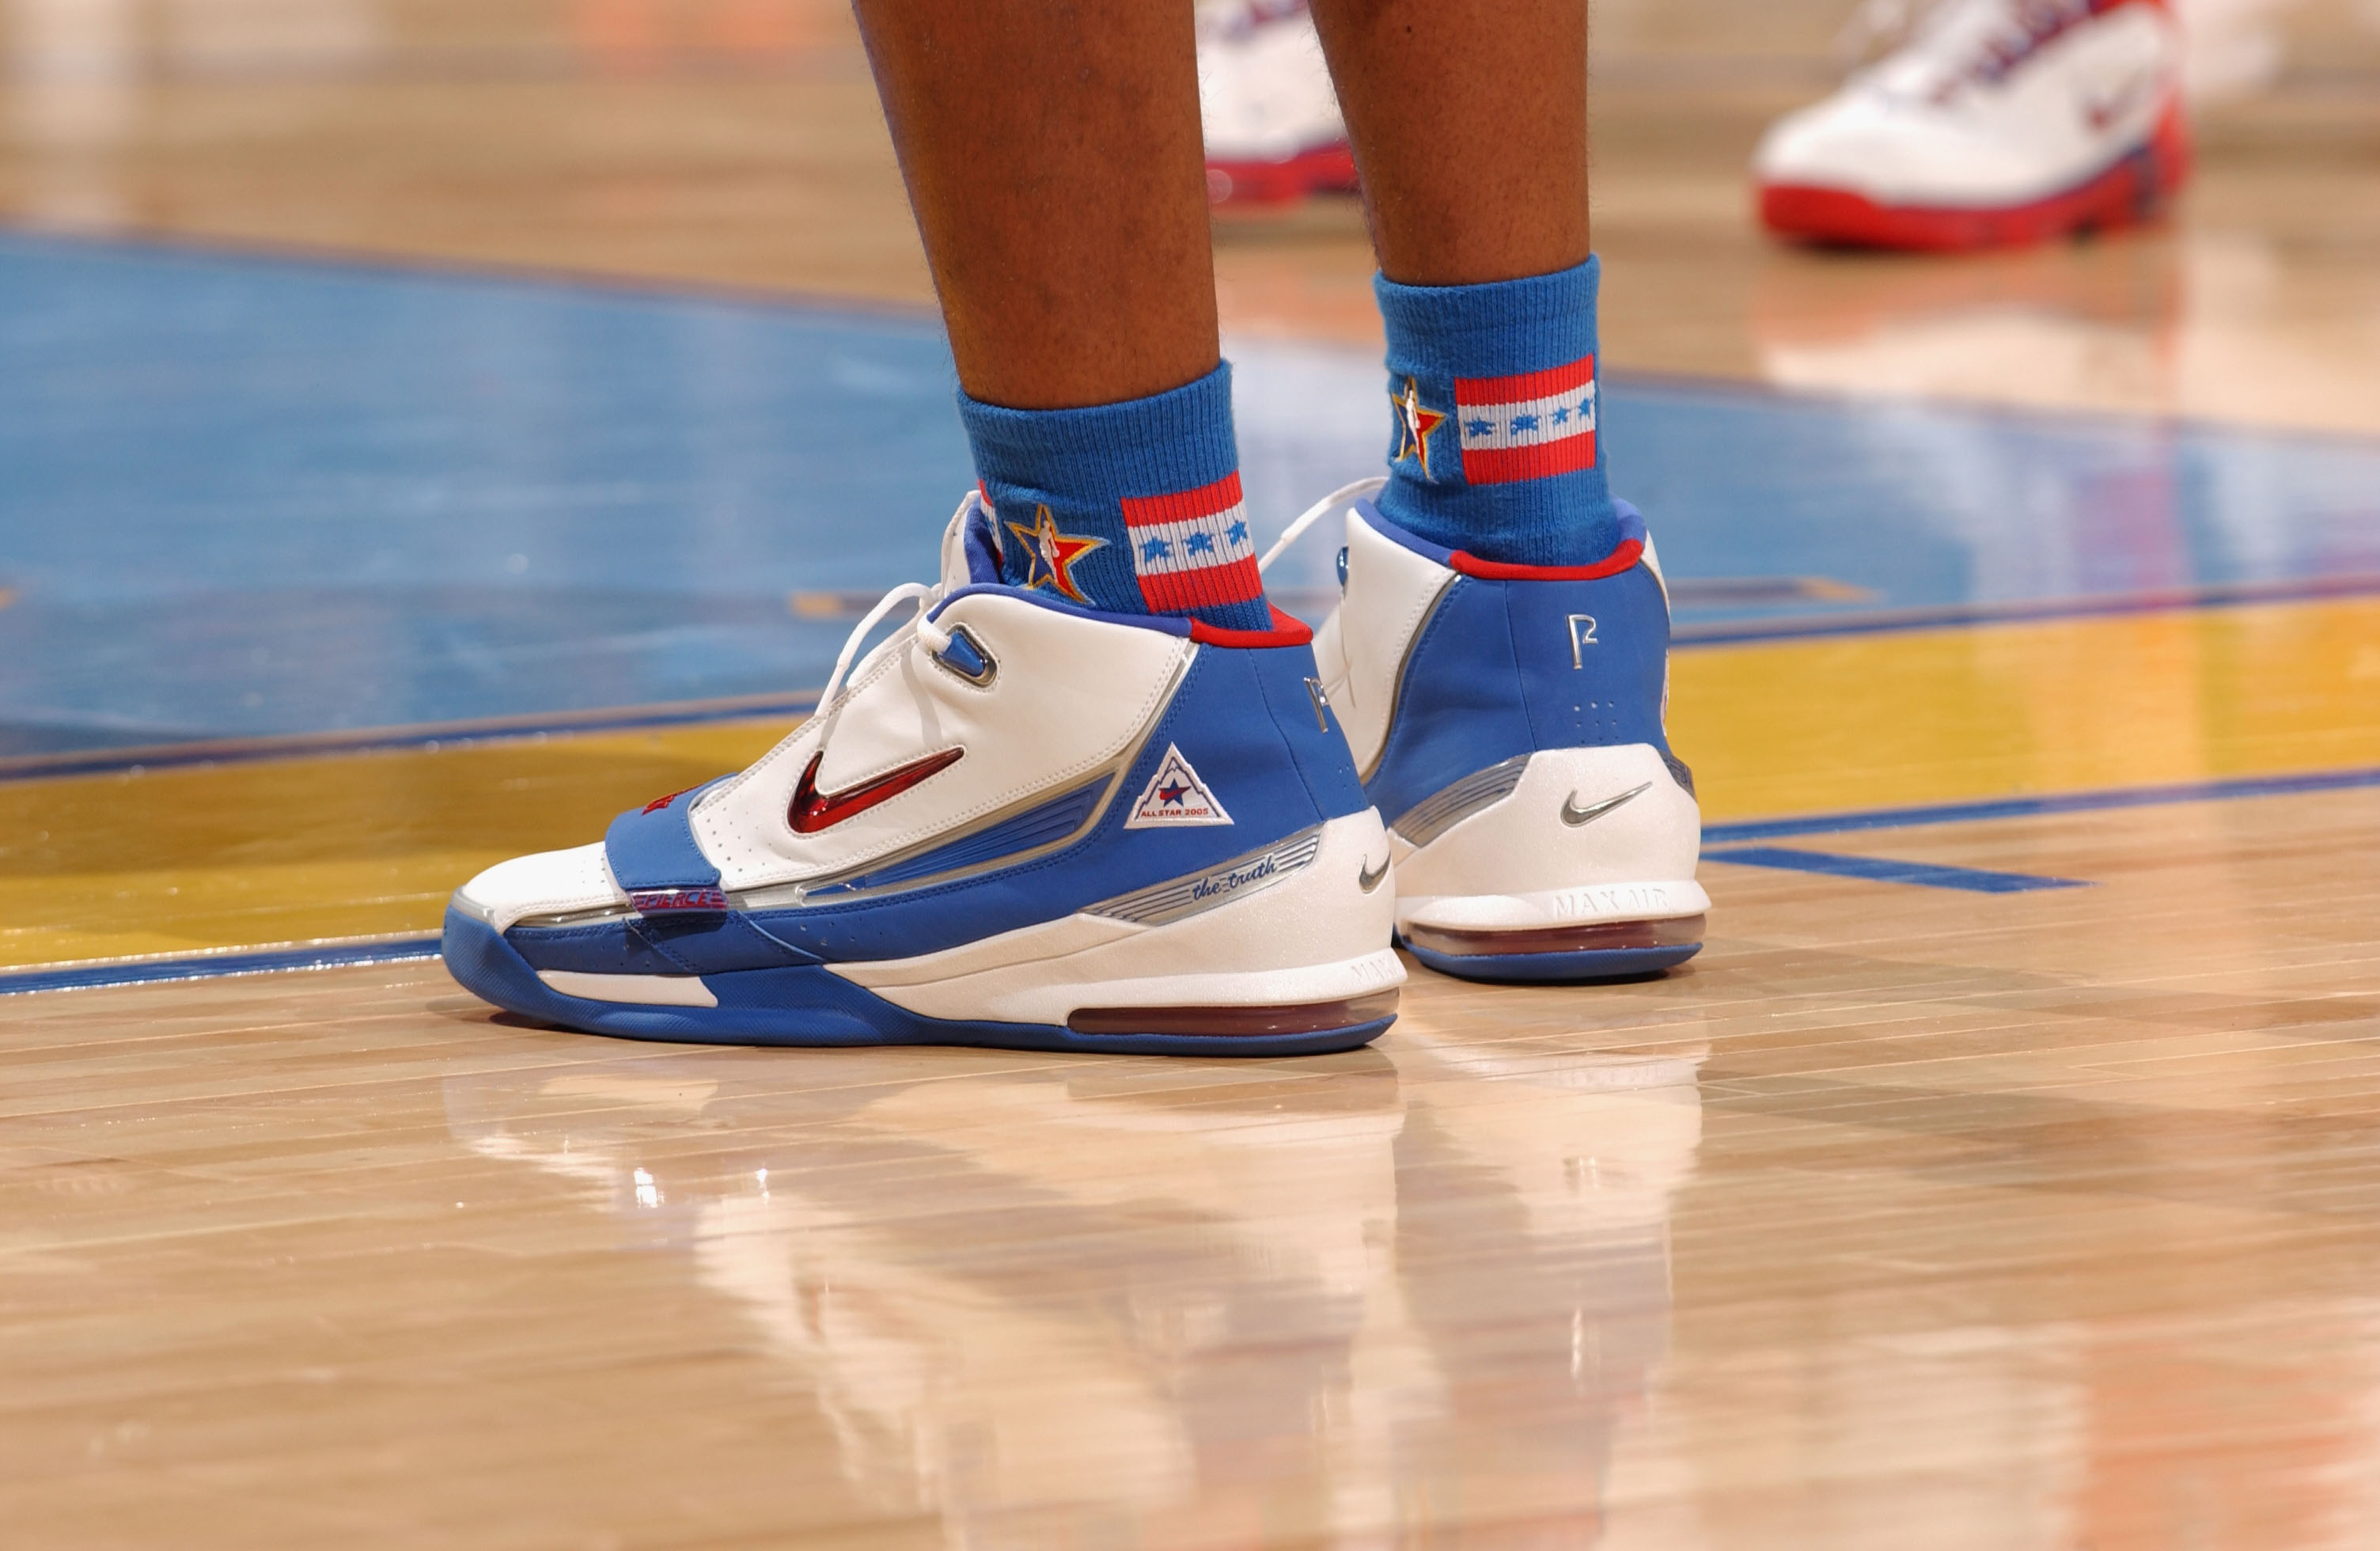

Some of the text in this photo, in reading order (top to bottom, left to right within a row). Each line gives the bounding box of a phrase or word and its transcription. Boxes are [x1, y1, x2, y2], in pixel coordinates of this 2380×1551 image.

[1184, 807, 1209, 816] 2005
[1192, 855, 1277, 901] the truth
[1554, 890, 1620, 919] MAX
